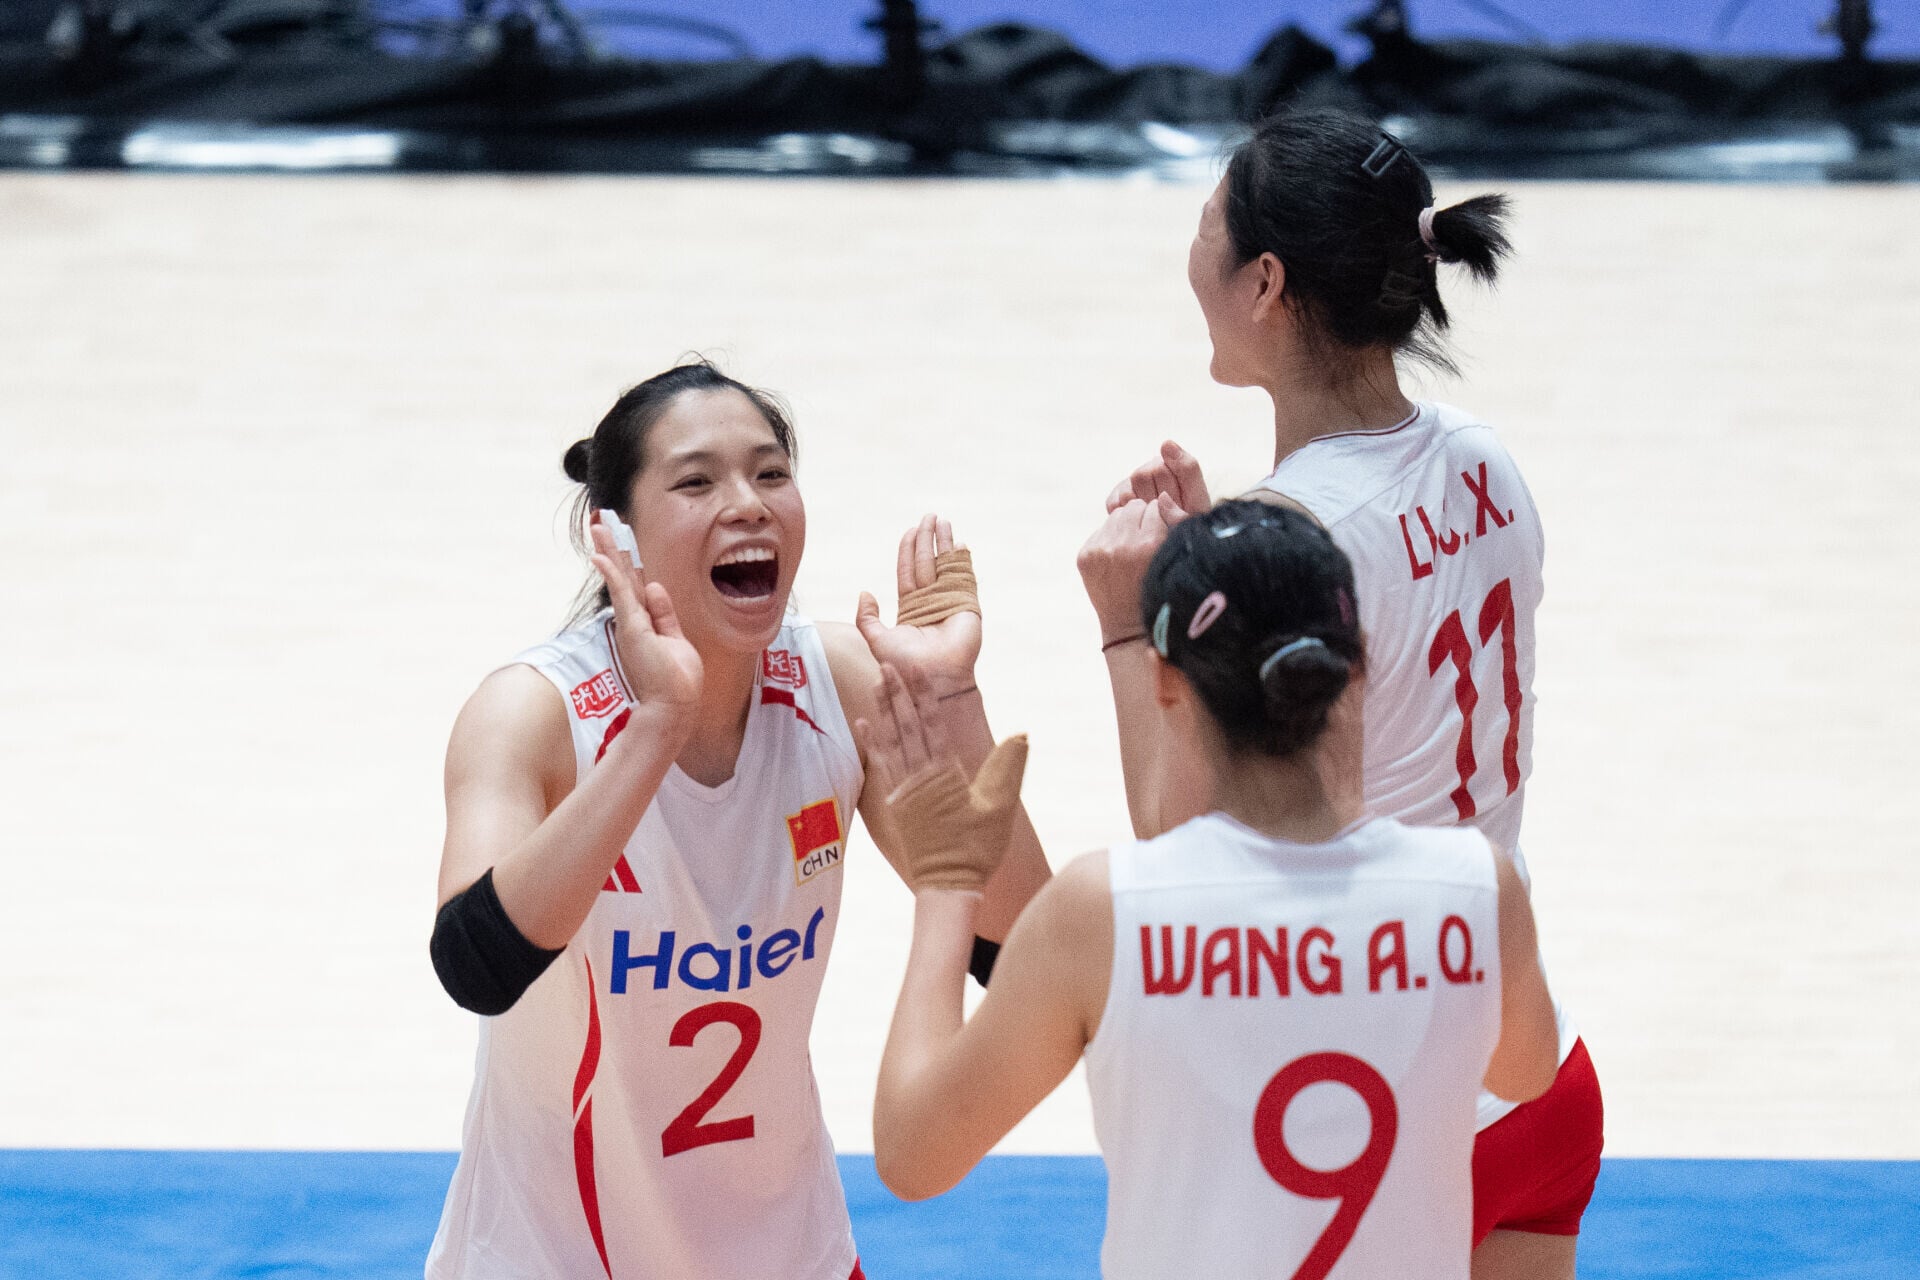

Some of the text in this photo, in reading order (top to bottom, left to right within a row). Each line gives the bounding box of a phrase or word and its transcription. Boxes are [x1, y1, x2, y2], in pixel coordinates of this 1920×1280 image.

[572, 671, 619, 713] 光明
[1428, 576, 1522, 821] 11
[802, 846, 839, 876] CHN
[610, 906, 825, 994] Haier
[1140, 924, 1343, 998] WANG
[661, 1001, 762, 1158] 2
[1253, 1051, 1399, 1280] 9
